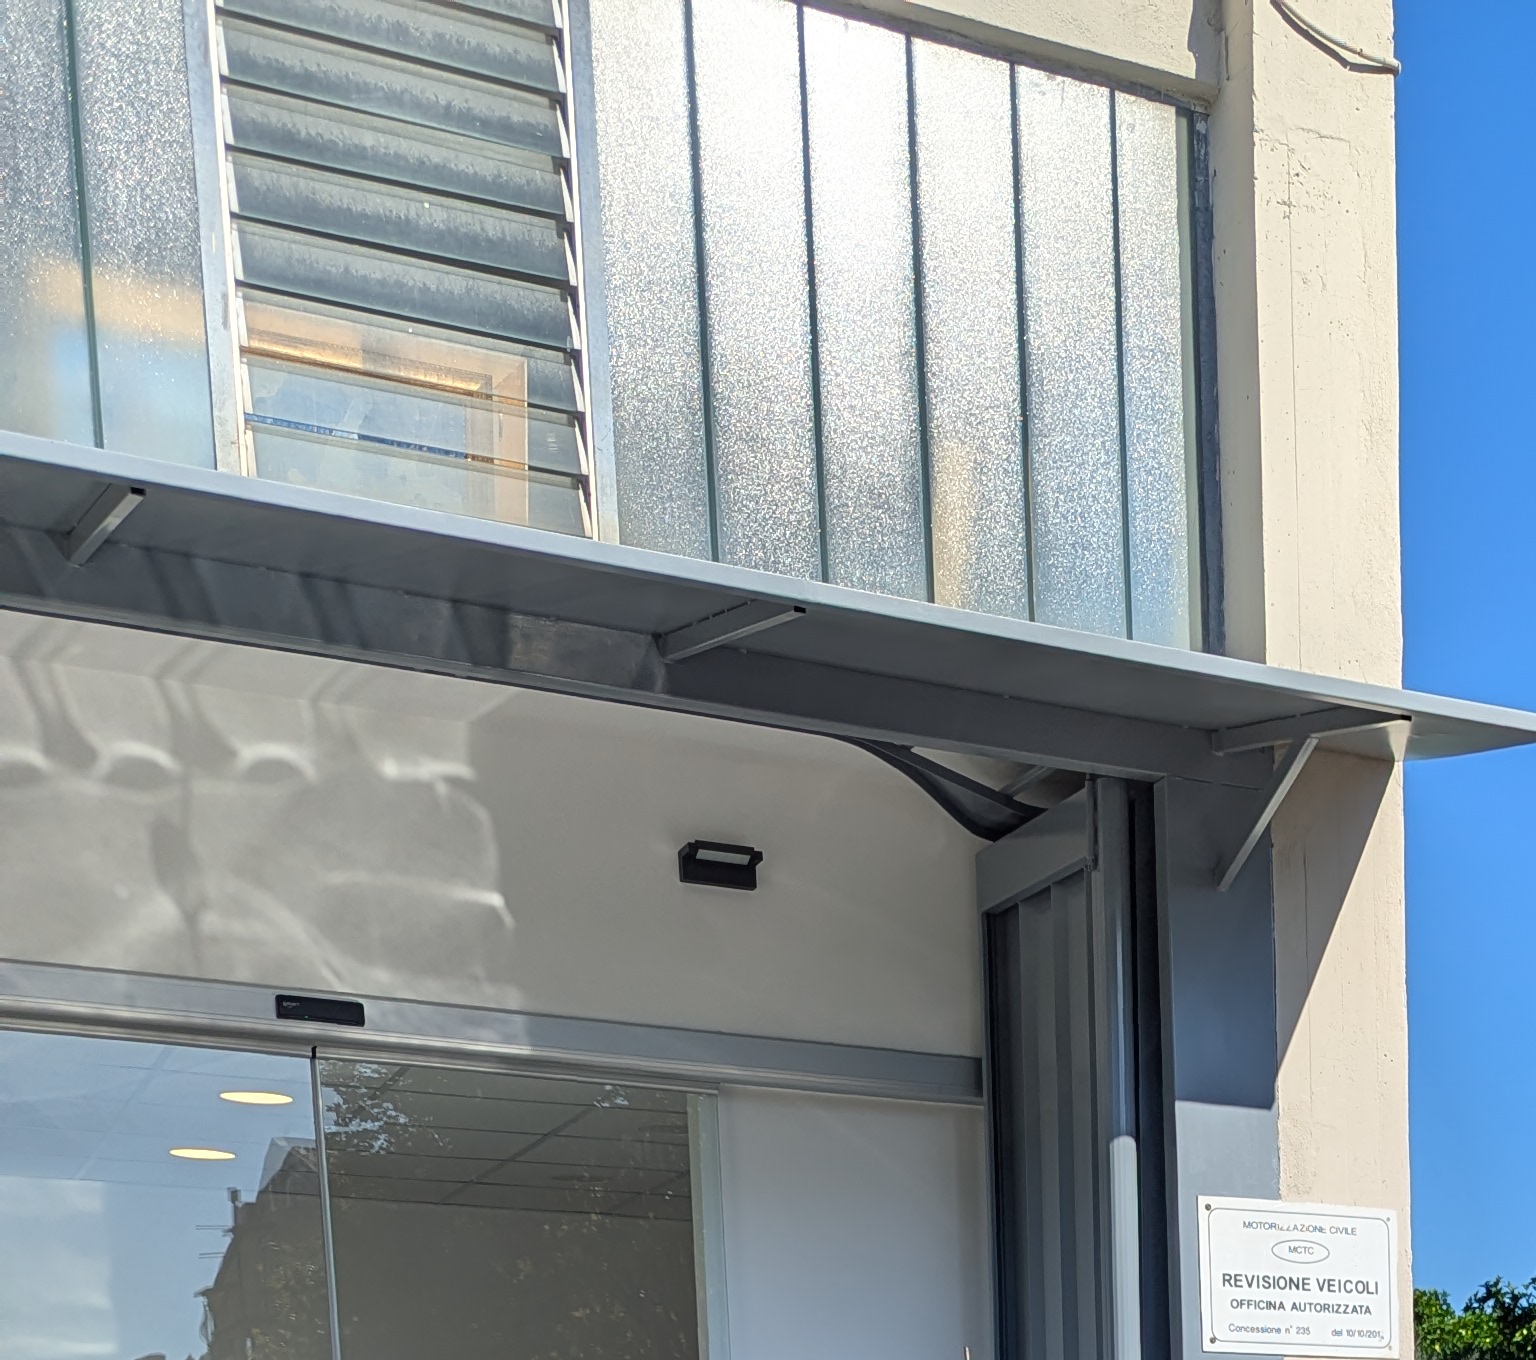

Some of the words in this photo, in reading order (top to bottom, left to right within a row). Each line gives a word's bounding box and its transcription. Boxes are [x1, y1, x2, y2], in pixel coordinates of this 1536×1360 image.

[1243, 1220, 1326, 1234] MOTORIZZAZIONE
[1329, 1226, 1357, 1236] CIVILE
[1288, 1245, 1314, 1255] MCTC
[1222, 1273, 1311, 1292] REVISIONE
[1316, 1279, 1378, 1295] VEICOLI
[1230, 1299, 1286, 1312] OFFICINA
[1290, 1302, 1372, 1315] AUTORIZZATA
[1228, 1323, 1281, 1334] Concessione
[1296, 1326, 1311, 1336] 235
[1331, 1329, 1343, 1337] del
